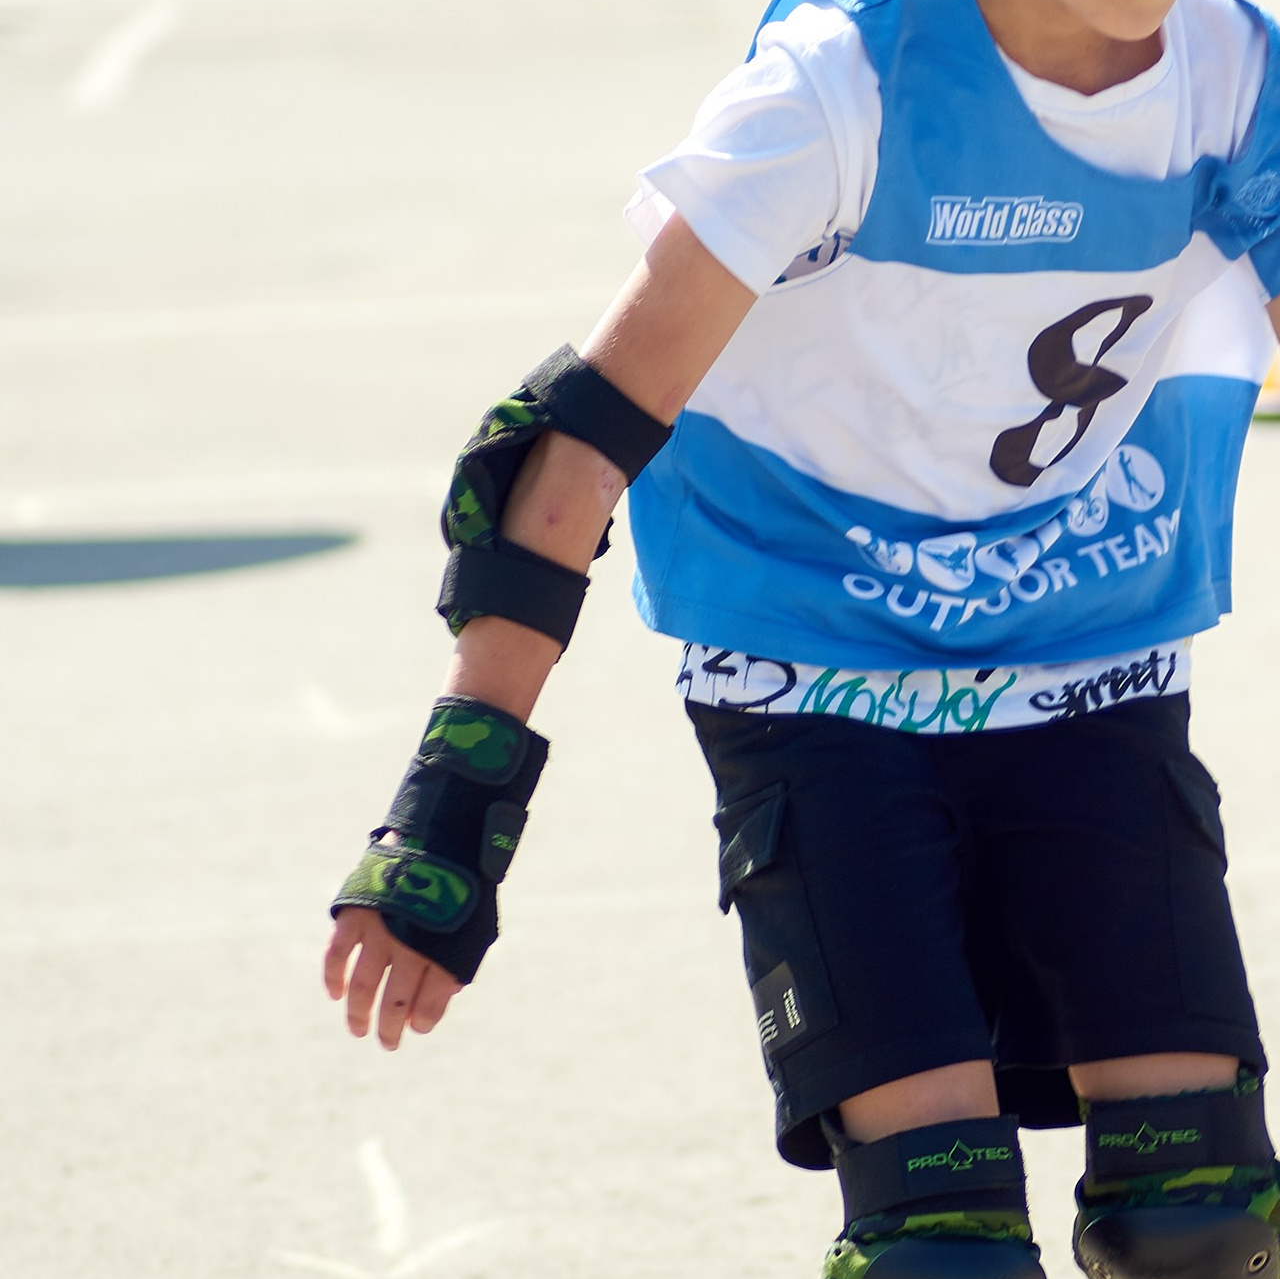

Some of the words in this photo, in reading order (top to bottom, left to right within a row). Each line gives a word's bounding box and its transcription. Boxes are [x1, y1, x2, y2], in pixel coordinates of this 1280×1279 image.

[933, 202, 1011, 240] World
[1008, 201, 1077, 239] Class
[990, 294, 1153, 488] 8
[1076, 507, 1182, 579] TEAM
[906, 1152, 948, 1173] PRO
[971, 1146, 1013, 1162] TEC
